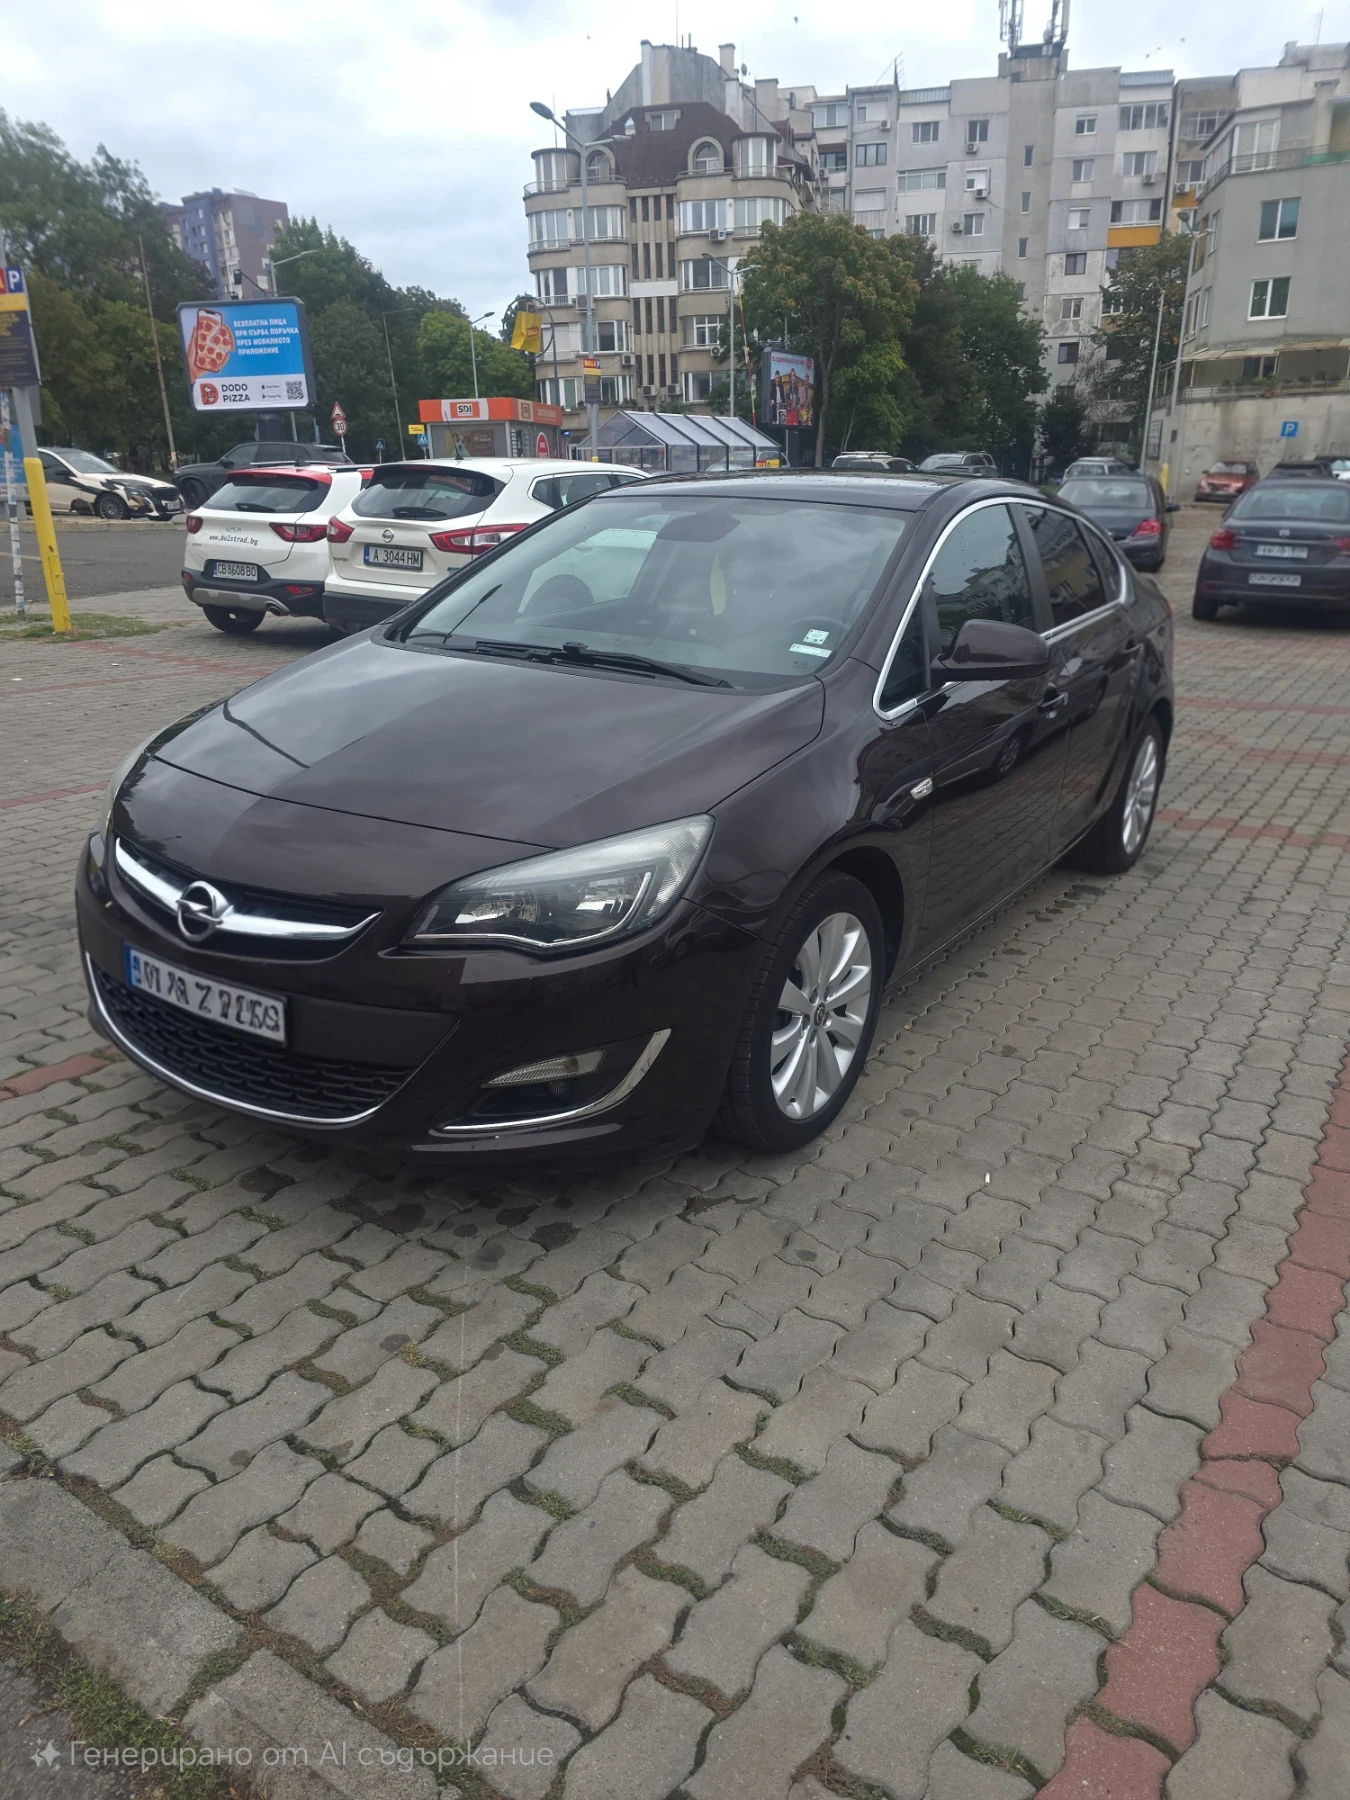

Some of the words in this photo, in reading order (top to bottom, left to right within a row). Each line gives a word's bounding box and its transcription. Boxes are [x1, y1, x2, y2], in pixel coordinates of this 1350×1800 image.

[8, 270, 20, 289] P
[269, 318, 287, 326] ПИЦА
[253, 337, 291, 345] МОБИЛНОТО
[238, 347, 279, 355] ПРИЛОЖЕНИЕ
[221, 384, 248, 392] DODO
[222, 394, 250, 402] PIZZA
[458, 405, 472, 413] SDI
[335, 422, 344, 431] 30
[1285, 423, 1295, 434] P
[209, 534, 258, 546] www.bulstrad.bg
[383, 550, 405, 563] 3044
[407, 552, 420, 565] HM
